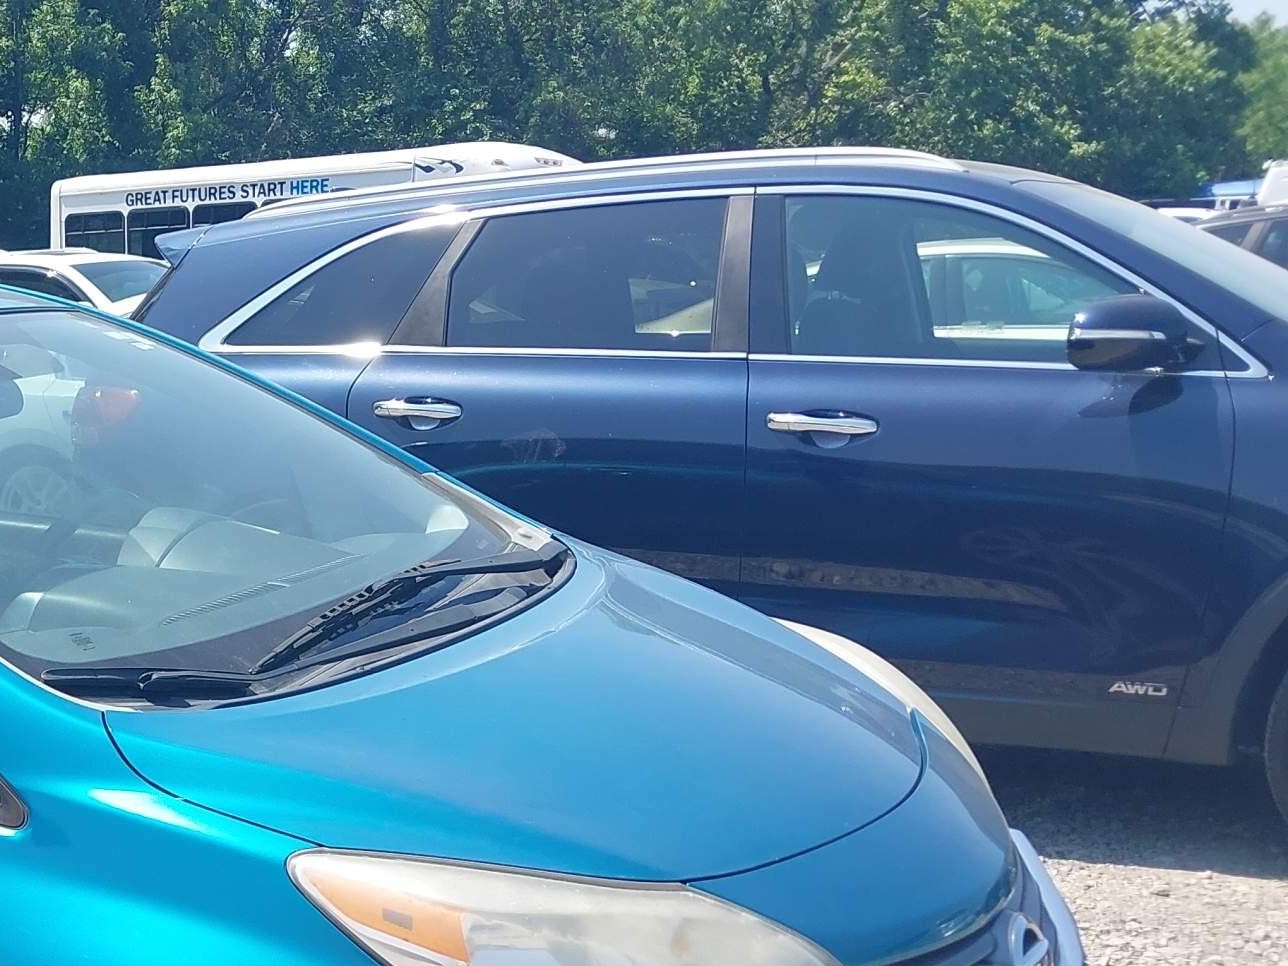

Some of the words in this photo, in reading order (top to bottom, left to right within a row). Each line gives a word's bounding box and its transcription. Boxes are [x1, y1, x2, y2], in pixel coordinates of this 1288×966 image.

[125, 190, 168, 206] GREAT
[171, 185, 236, 203] FUTURES
[240, 181, 286, 198] START
[290, 178, 330, 196] HERE
[1108, 680, 1168, 696] AWD
